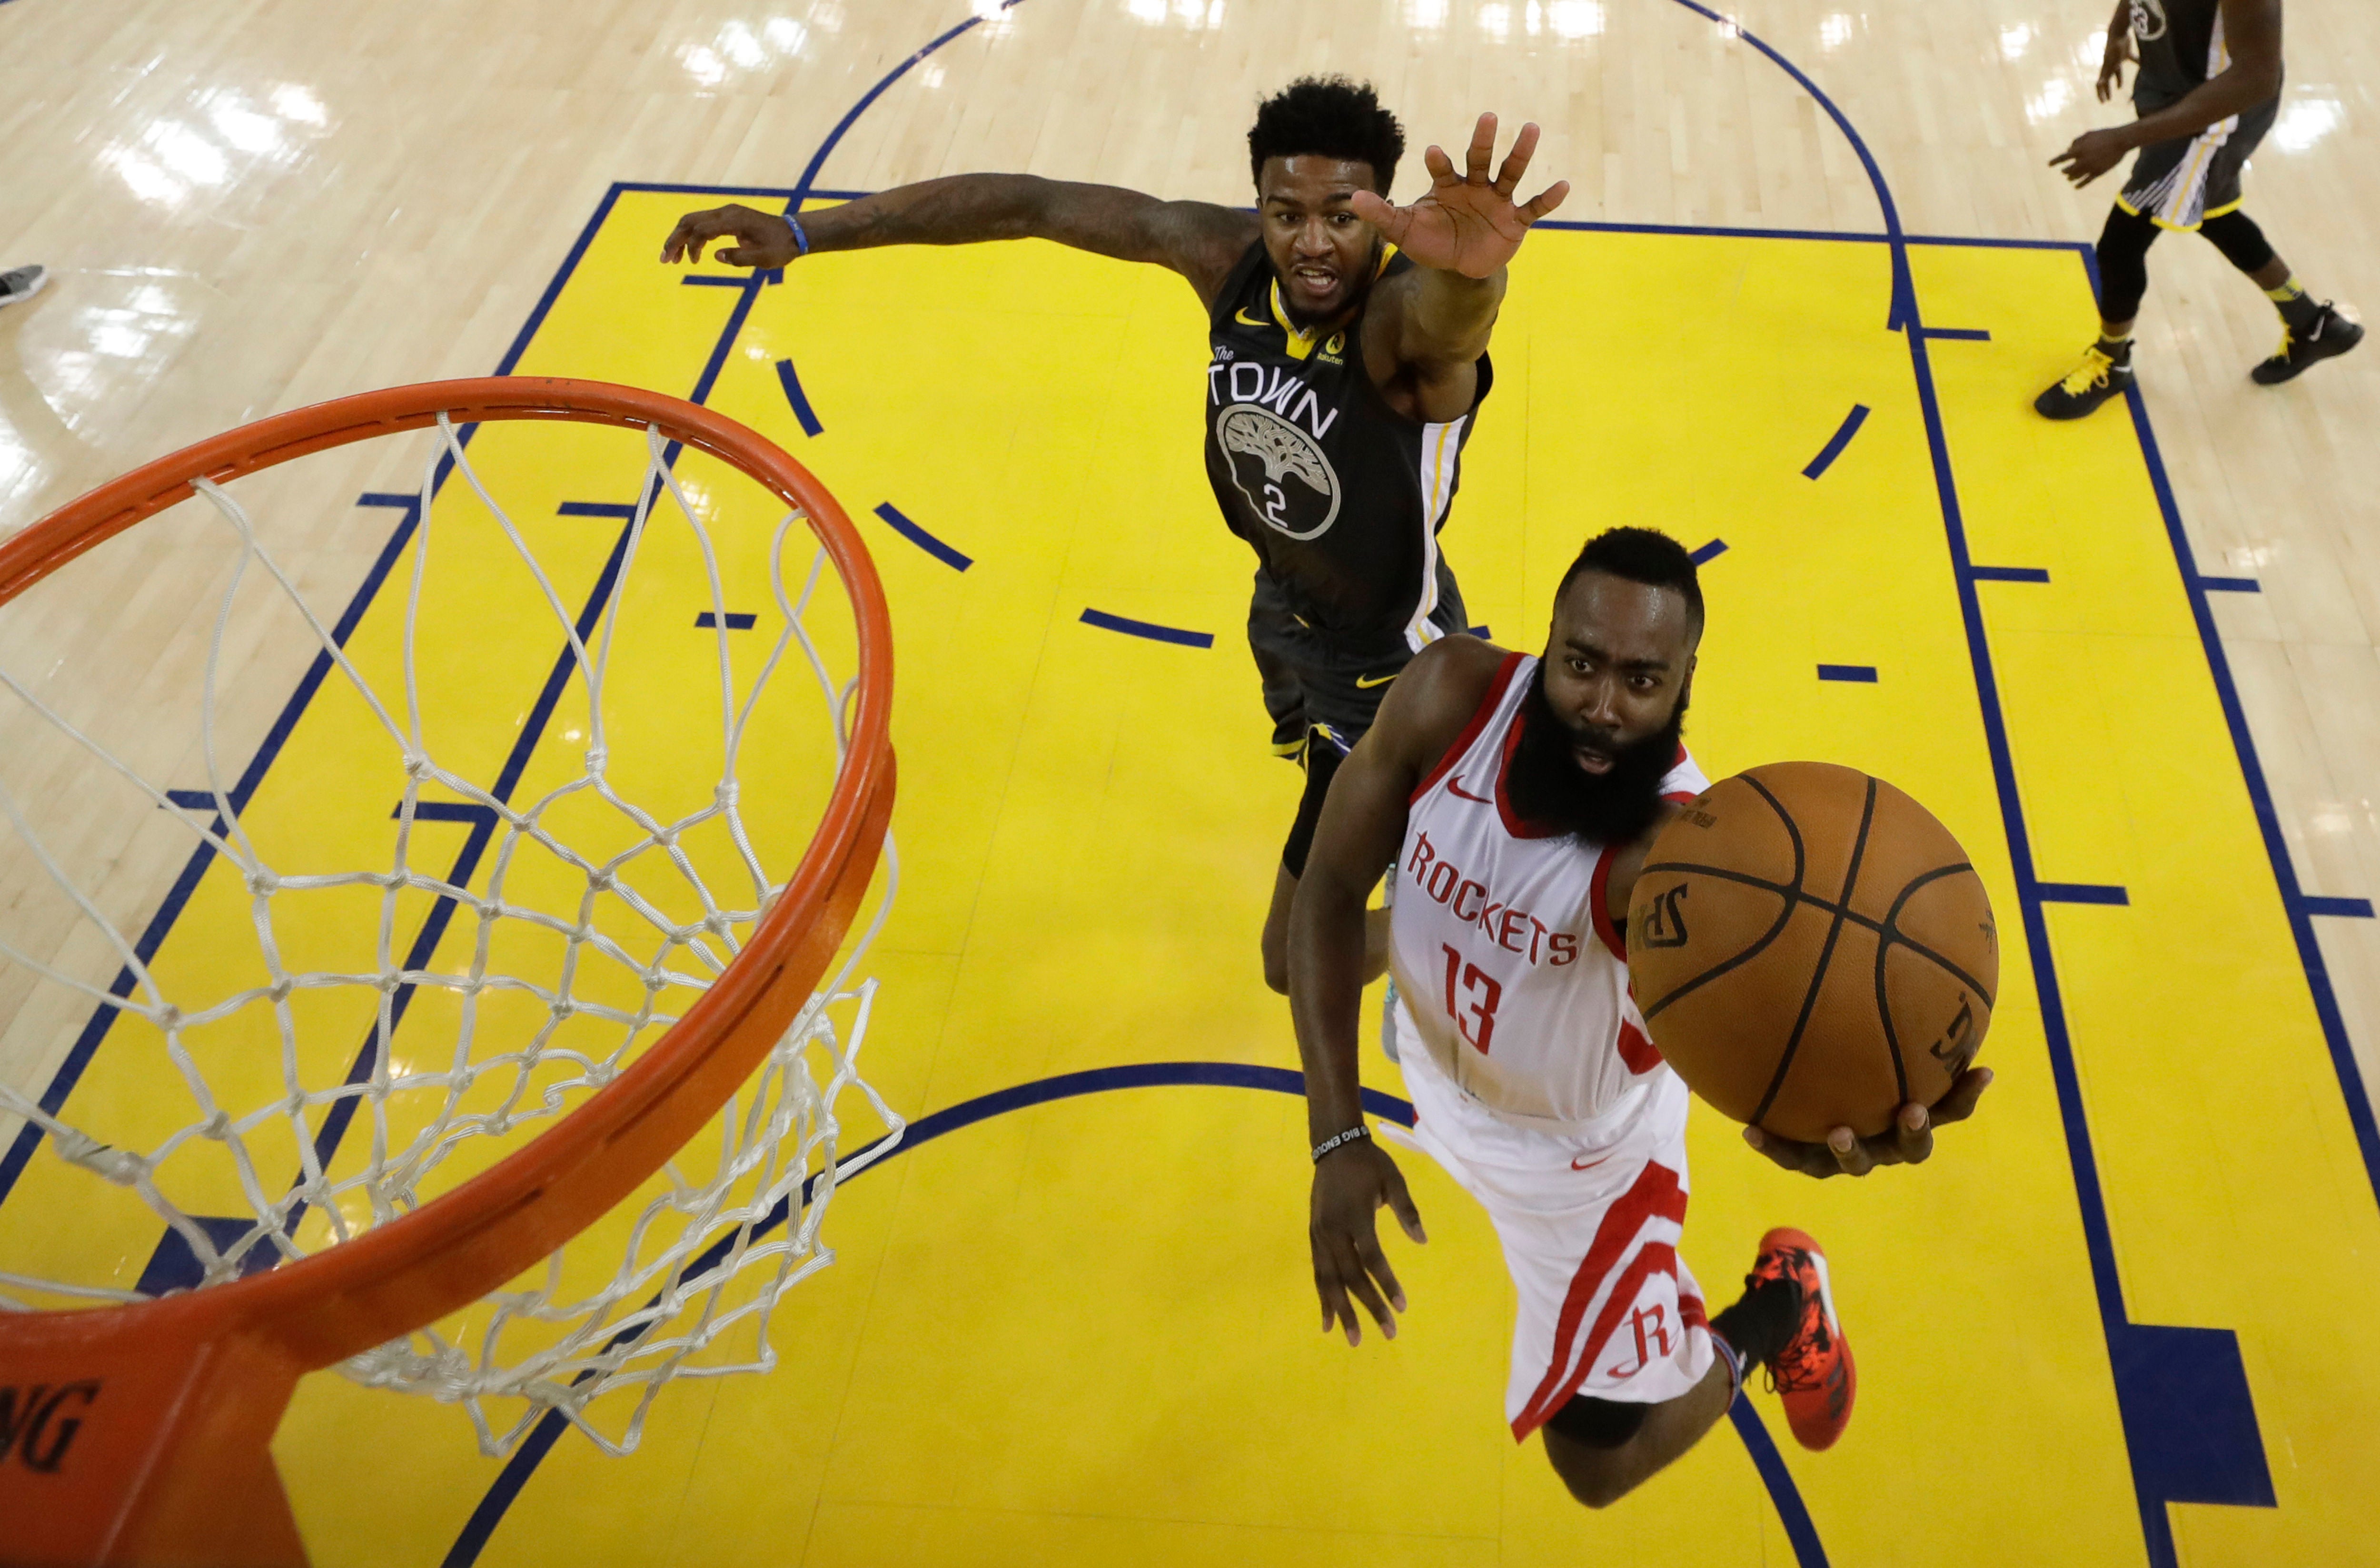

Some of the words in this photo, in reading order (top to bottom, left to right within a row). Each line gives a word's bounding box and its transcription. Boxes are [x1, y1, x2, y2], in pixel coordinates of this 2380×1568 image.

[1214, 345, 1234, 362] The
[1317, 353, 1343, 365] Rakuten
[1208, 362, 1338, 440] TOWN
[1264, 483, 1289, 529] 2
[1407, 830, 1577, 966] ROCKETS
[1442, 942, 1502, 1055] 13
[1341, 1127, 1360, 1142] BIG
